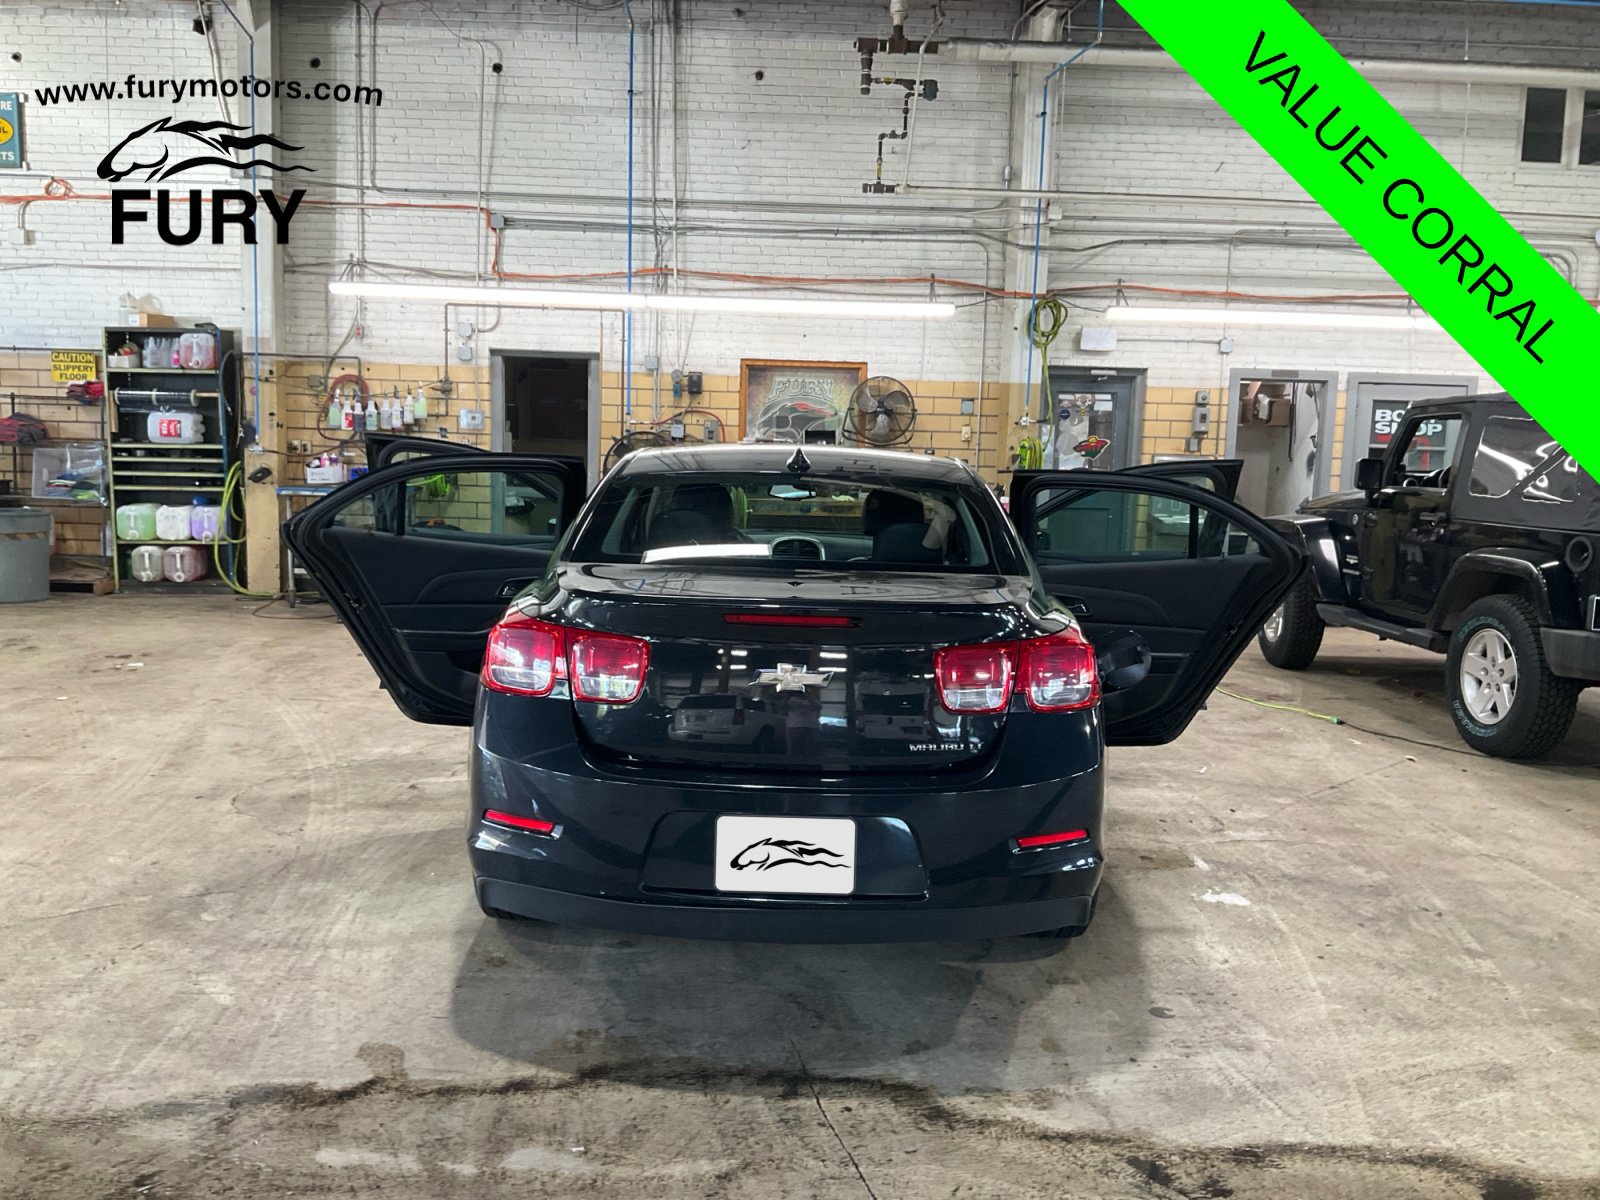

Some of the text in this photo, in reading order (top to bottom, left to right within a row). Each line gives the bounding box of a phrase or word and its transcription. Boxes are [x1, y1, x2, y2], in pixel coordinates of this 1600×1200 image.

[0, 151, 15, 161] TS
[52, 352, 94, 362] CAUTION
[52, 364, 94, 372] SLIPPERY
[768, 377, 833, 402] FURY
[908, 743, 964, 752] MALIBU
